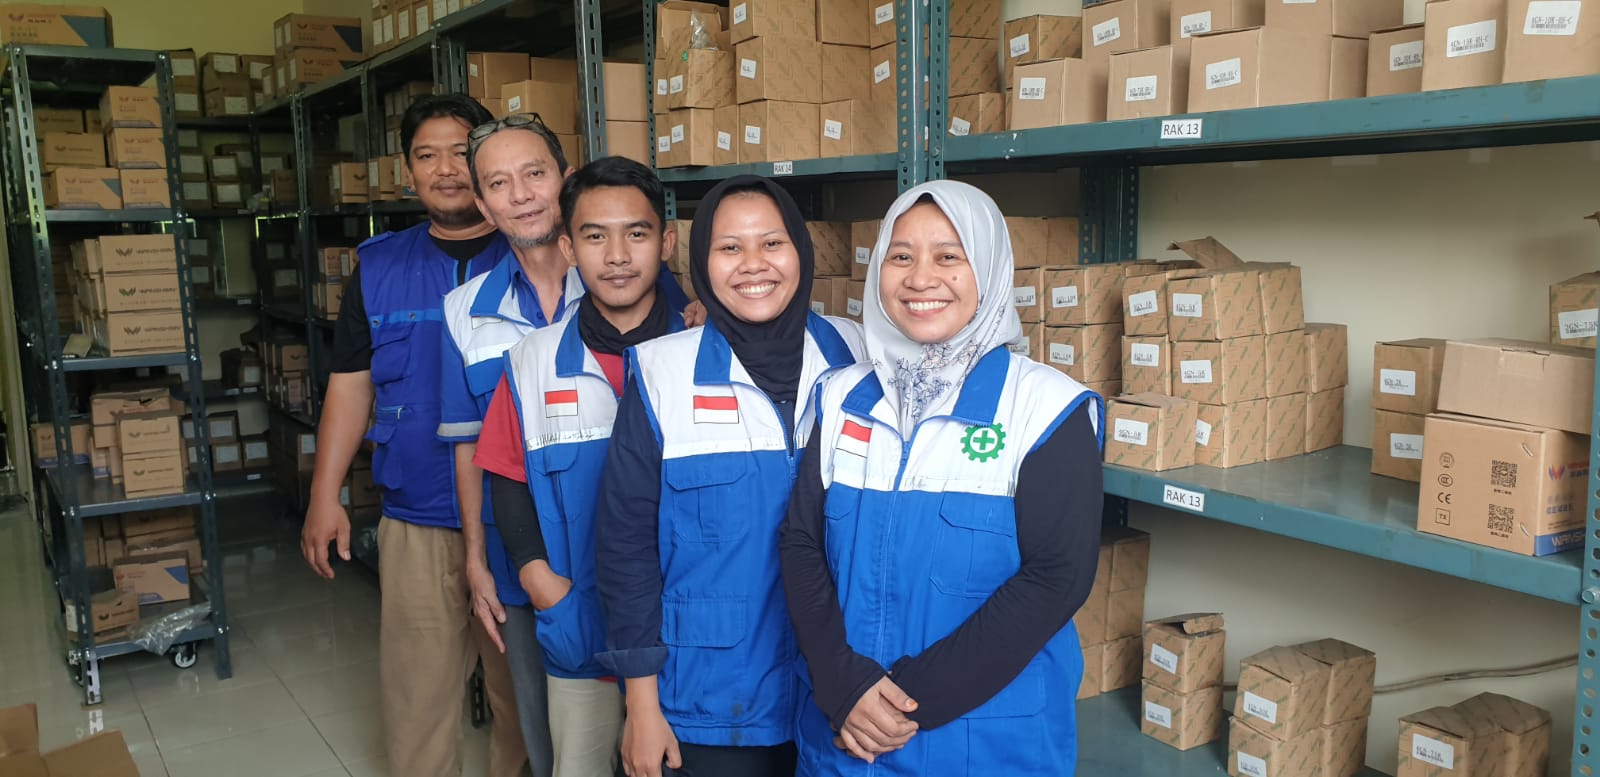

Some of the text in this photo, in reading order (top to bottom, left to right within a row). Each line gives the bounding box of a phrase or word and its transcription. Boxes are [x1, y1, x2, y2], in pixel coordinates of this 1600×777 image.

[1163, 123, 1199, 135] RAK 13
[774, 163, 785, 173] RAK
[1166, 489, 1201, 507] RAK 13
